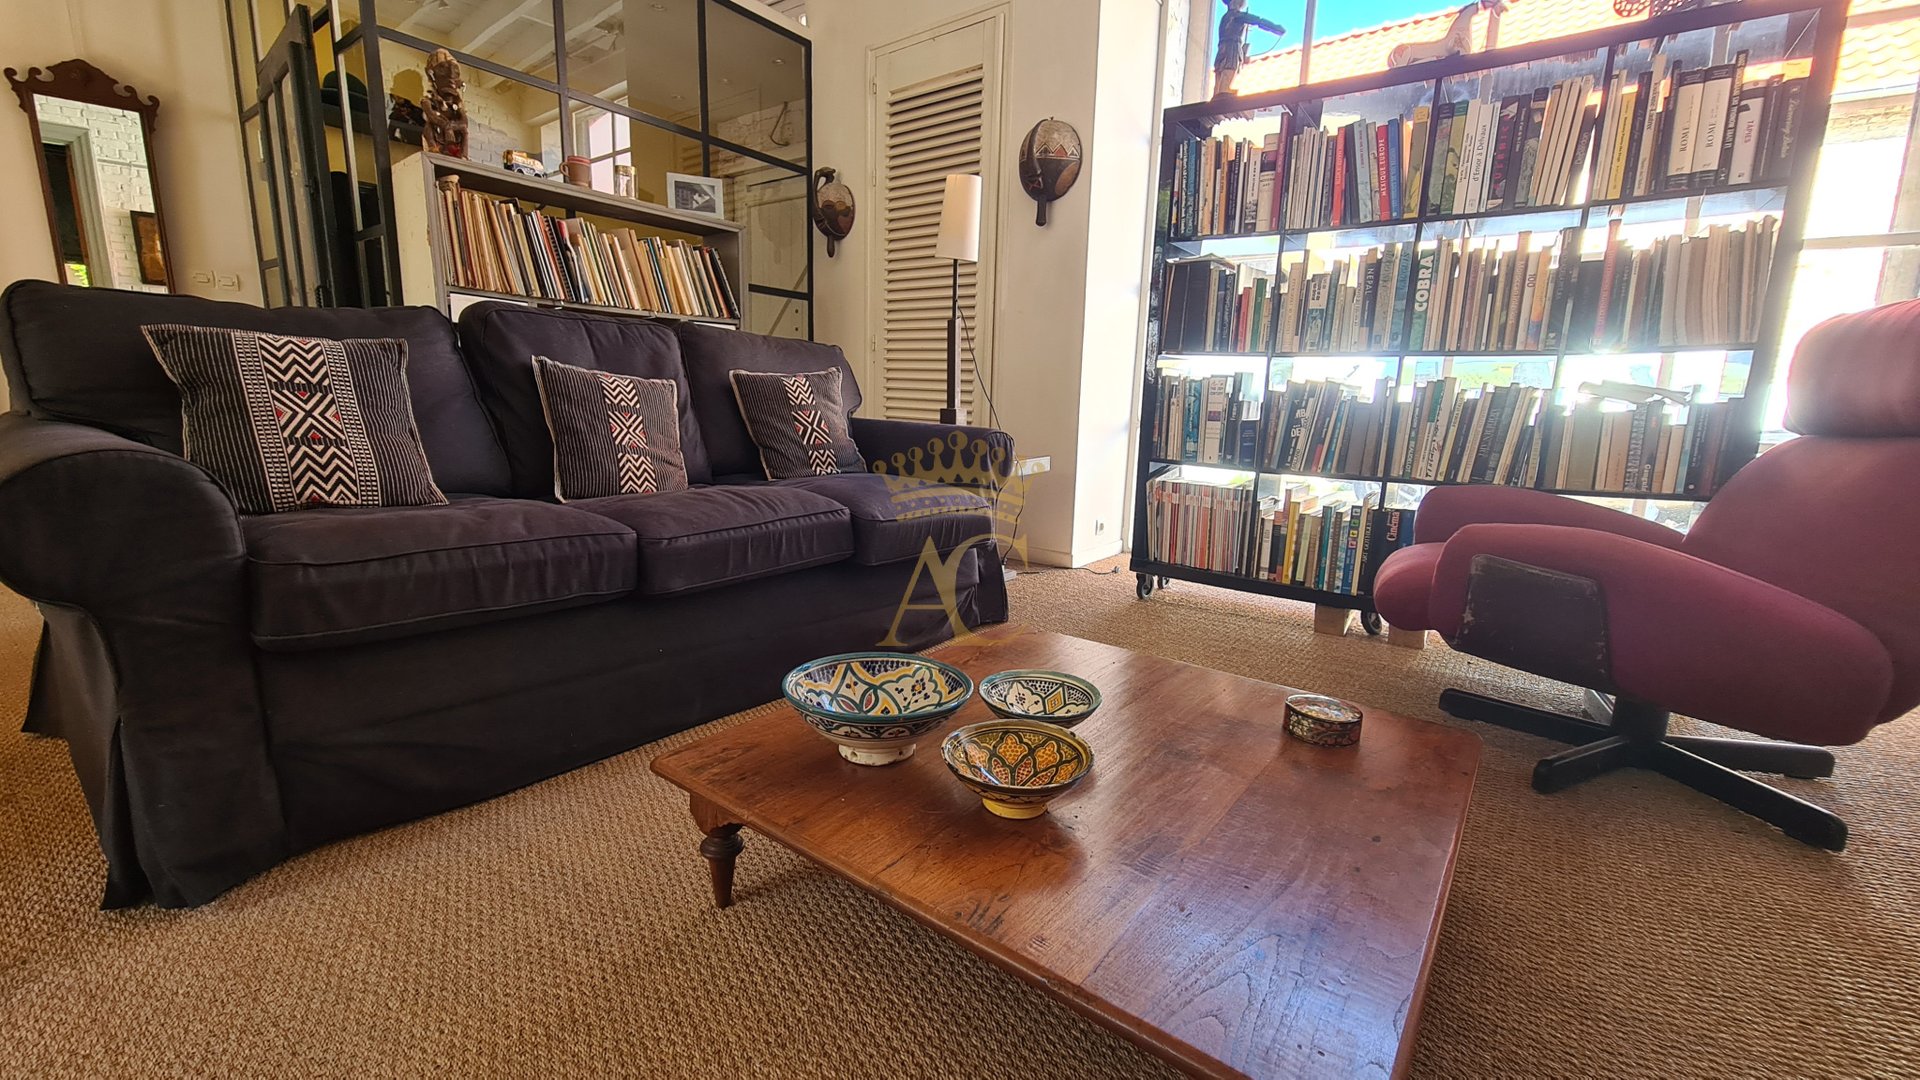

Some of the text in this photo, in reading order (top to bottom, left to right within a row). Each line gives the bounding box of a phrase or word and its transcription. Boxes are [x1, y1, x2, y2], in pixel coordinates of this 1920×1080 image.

[1472, 159, 1483, 182] d'Ensor
[1478, 124, 1487, 150] Delvaux
[1365, 268, 1375, 295] NEPAL
[1414, 254, 1434, 312] COBRA
[1526, 273, 1536, 288] 100
[1386, 511, 1400, 541] Cinéma
